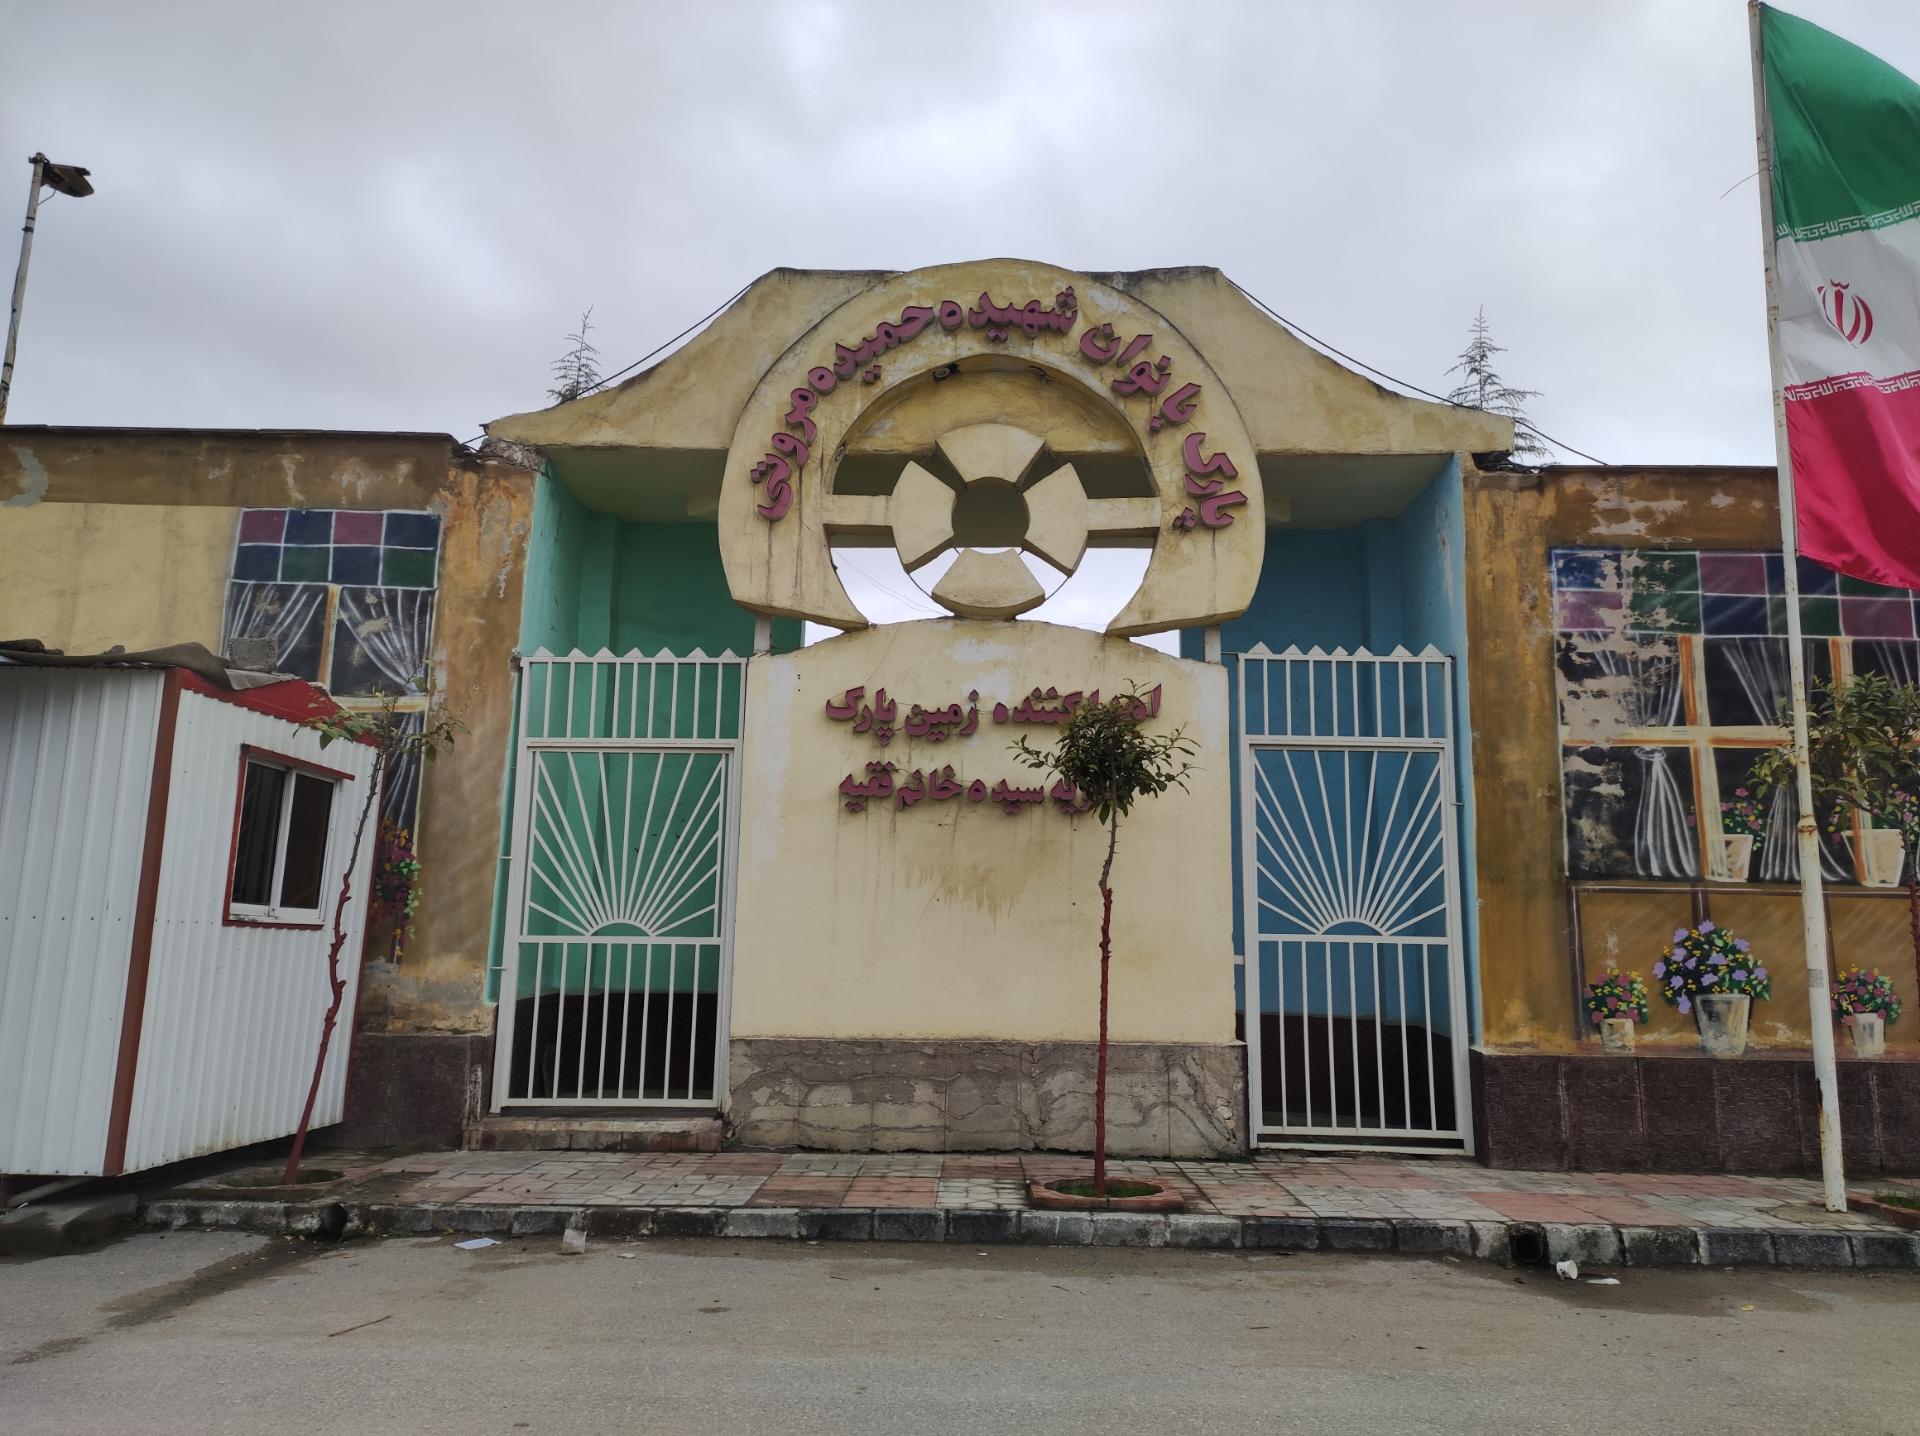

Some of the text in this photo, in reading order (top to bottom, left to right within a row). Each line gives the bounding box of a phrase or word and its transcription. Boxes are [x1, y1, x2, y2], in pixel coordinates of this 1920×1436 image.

[938, 285, 1078, 343] شهیده
[807, 305, 934, 395] حمیده
[1079, 322, 1202, 432] بانوان
[1172, 431, 1248, 531] پارک
[825, 685, 897, 746] پارک
[904, 688, 979, 742] زمین
[838, 760, 896, 812] فقیه
[896, 764, 963, 811] خانم
[968, 777, 1045, 815] سیده
